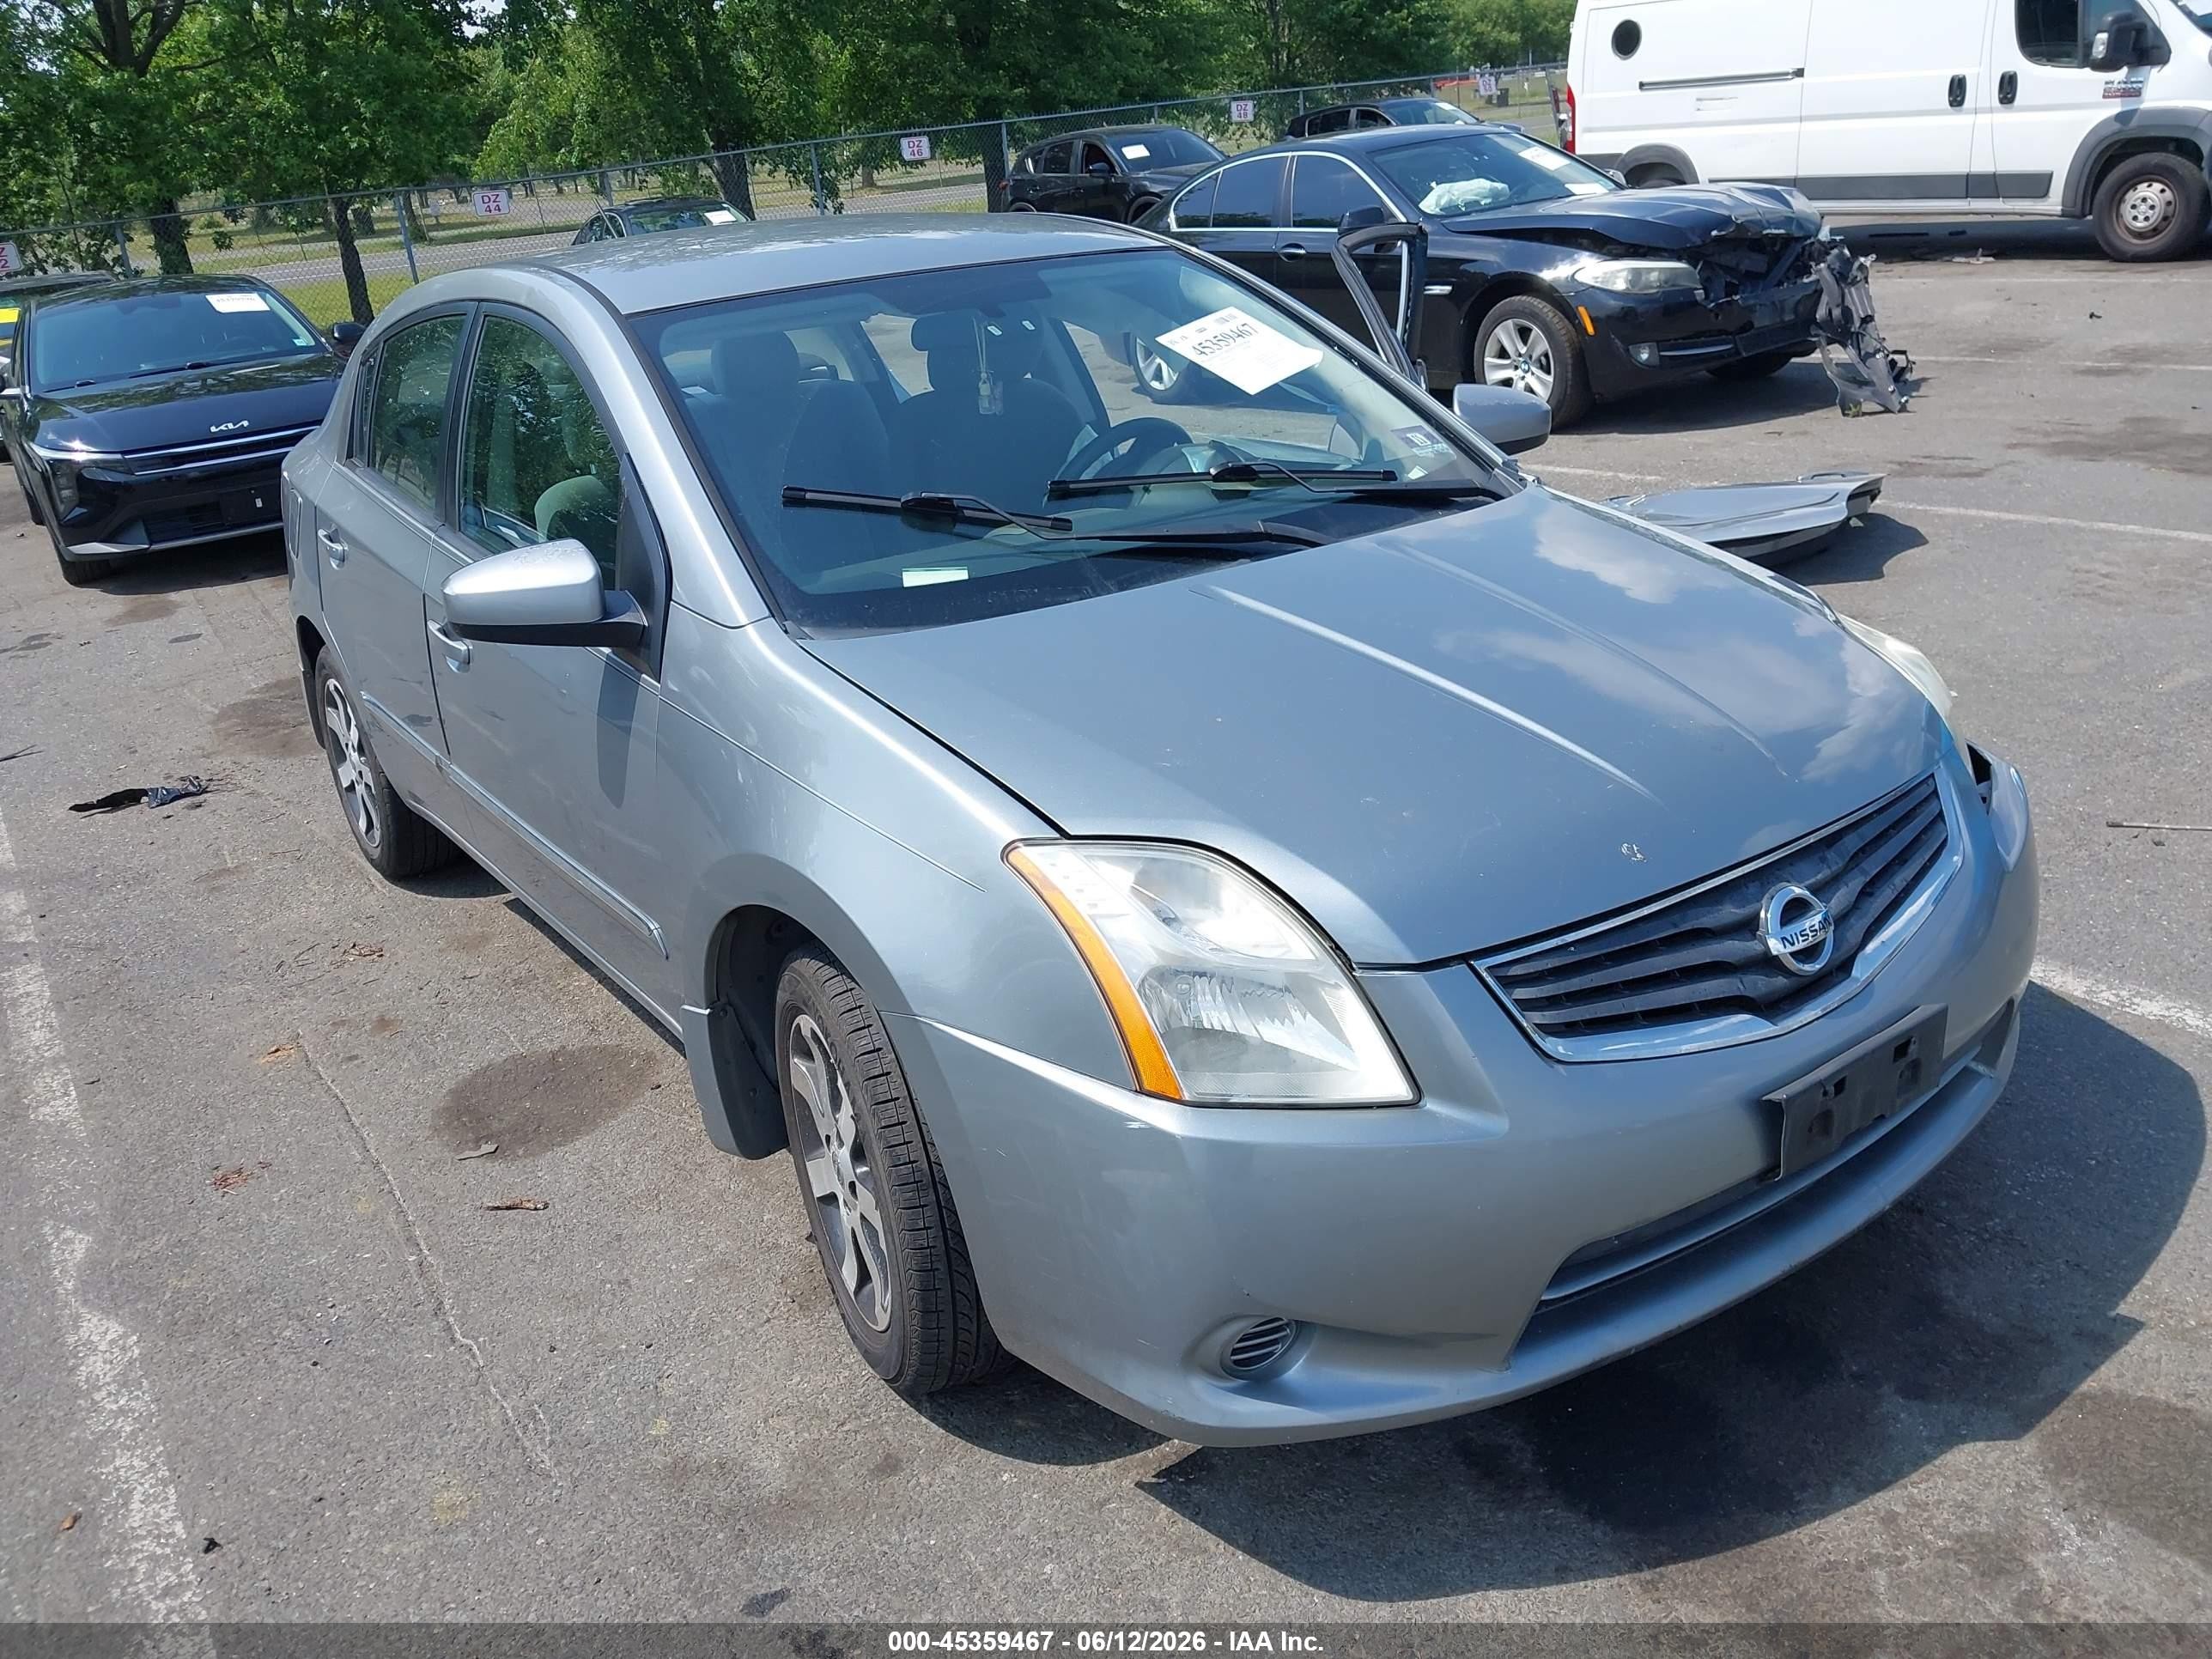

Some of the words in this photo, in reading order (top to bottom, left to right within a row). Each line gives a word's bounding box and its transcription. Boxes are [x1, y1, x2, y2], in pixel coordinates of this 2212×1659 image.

[908, 140, 923, 149] DZ
[910, 149, 923, 157] 46
[481, 194, 501, 204] DZ
[484, 204, 501, 213] 44
[1192, 323, 1259, 356] 45359467
[1780, 916, 1832, 950] NISSAN
